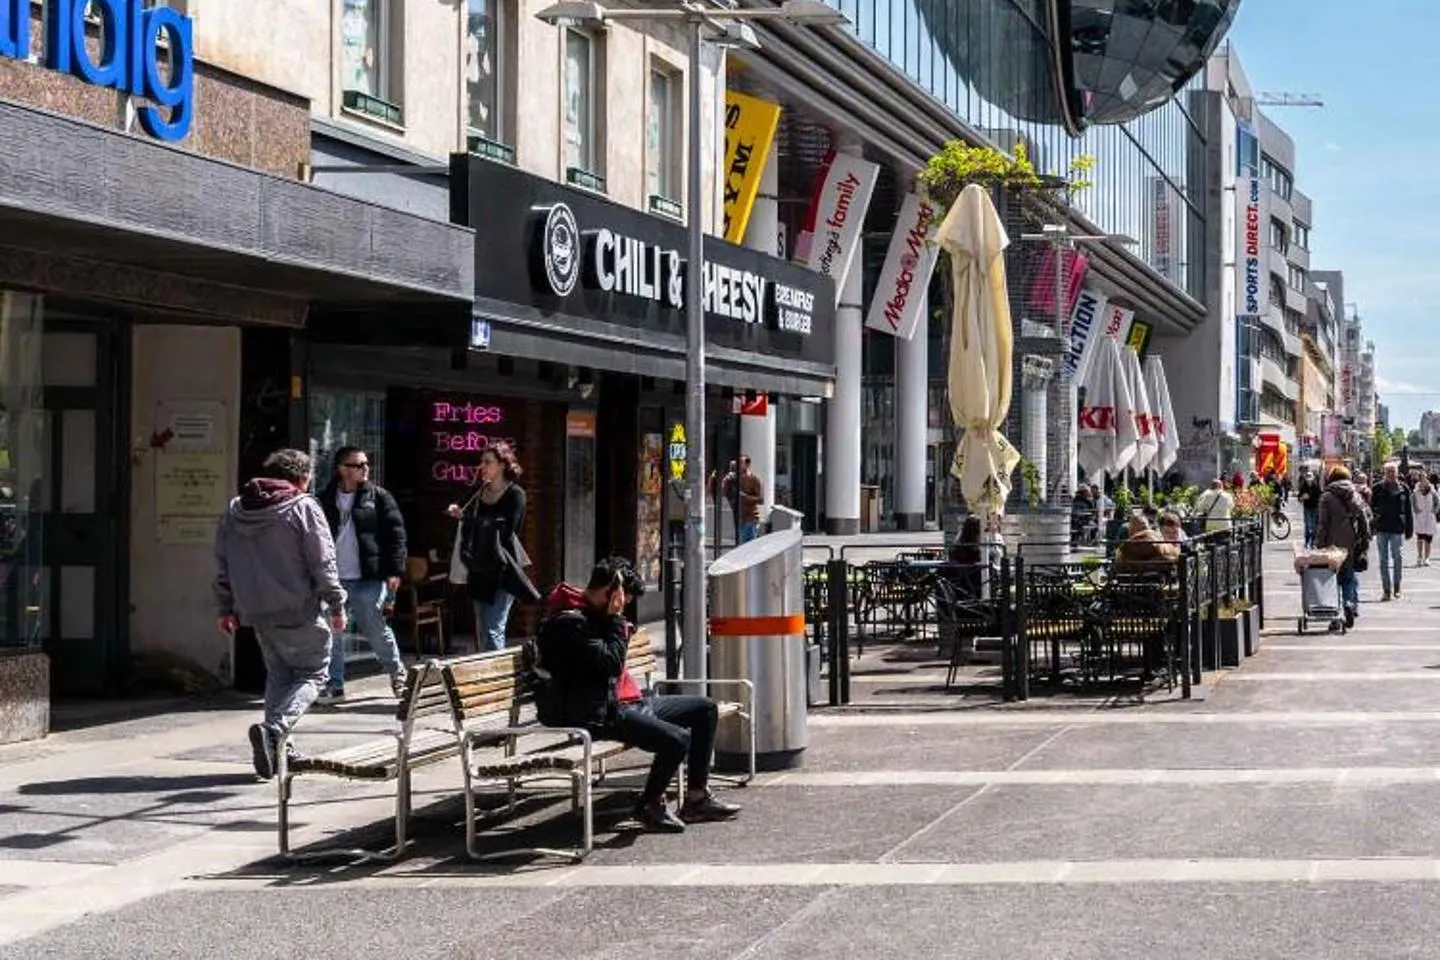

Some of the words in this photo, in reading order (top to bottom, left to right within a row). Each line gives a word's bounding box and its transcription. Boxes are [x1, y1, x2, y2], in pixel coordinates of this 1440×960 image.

[827, 172, 861, 228] family
[596, 228, 661, 301] CHILI
[668, 249, 683, 310] &
[702, 260, 765, 324] HEESY
[1063, 292, 1098, 372] ACTION
[432, 401, 502, 424] Fries
[432, 461, 481, 487] Guy
